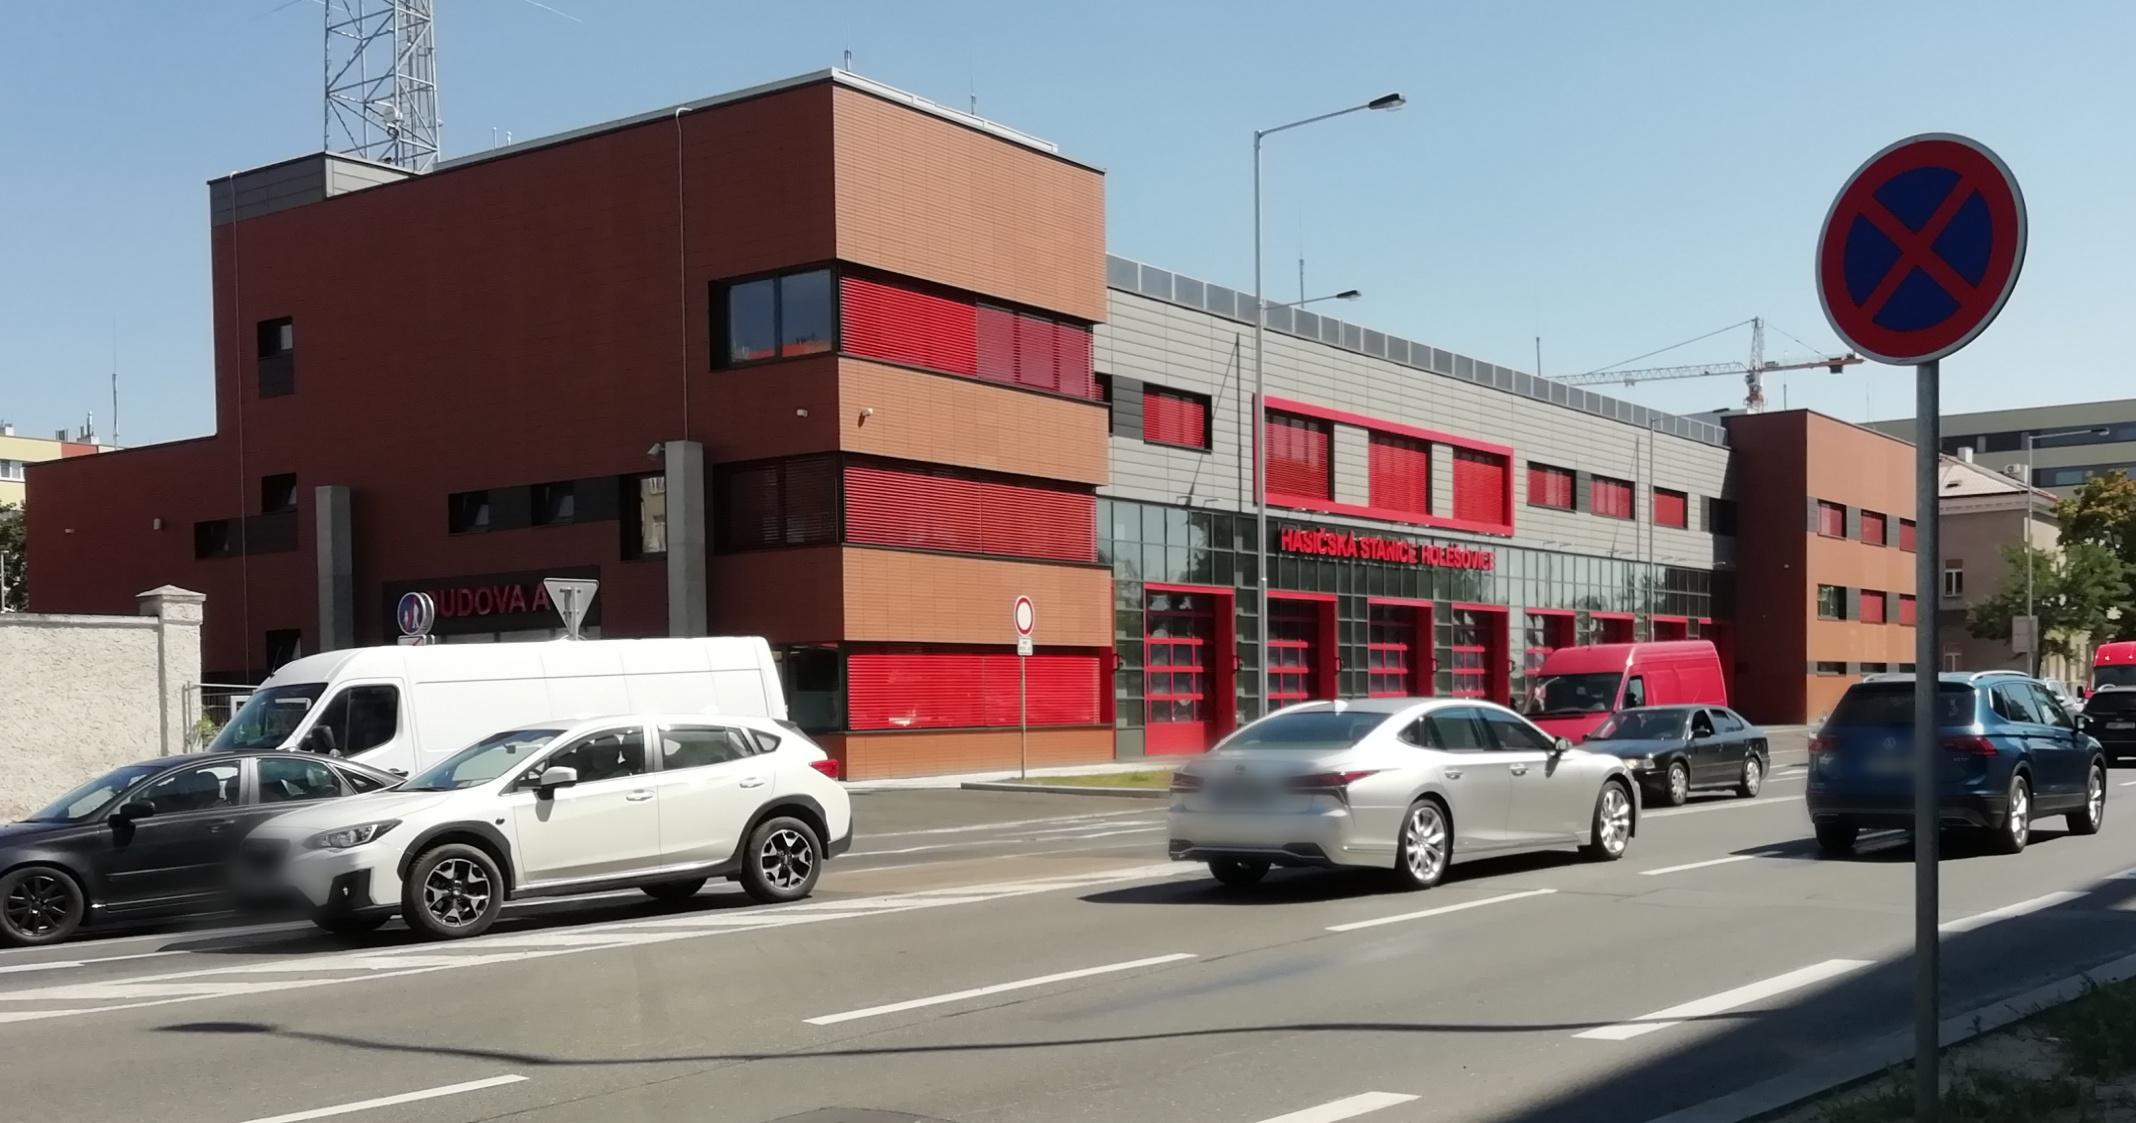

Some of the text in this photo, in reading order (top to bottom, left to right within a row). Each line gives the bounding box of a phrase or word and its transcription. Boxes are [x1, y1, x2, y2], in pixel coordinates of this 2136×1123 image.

[1281, 527, 1496, 571] HASIČSKÁ STANICE HOLEŠOVICE
[532, 582, 552, 612] A
